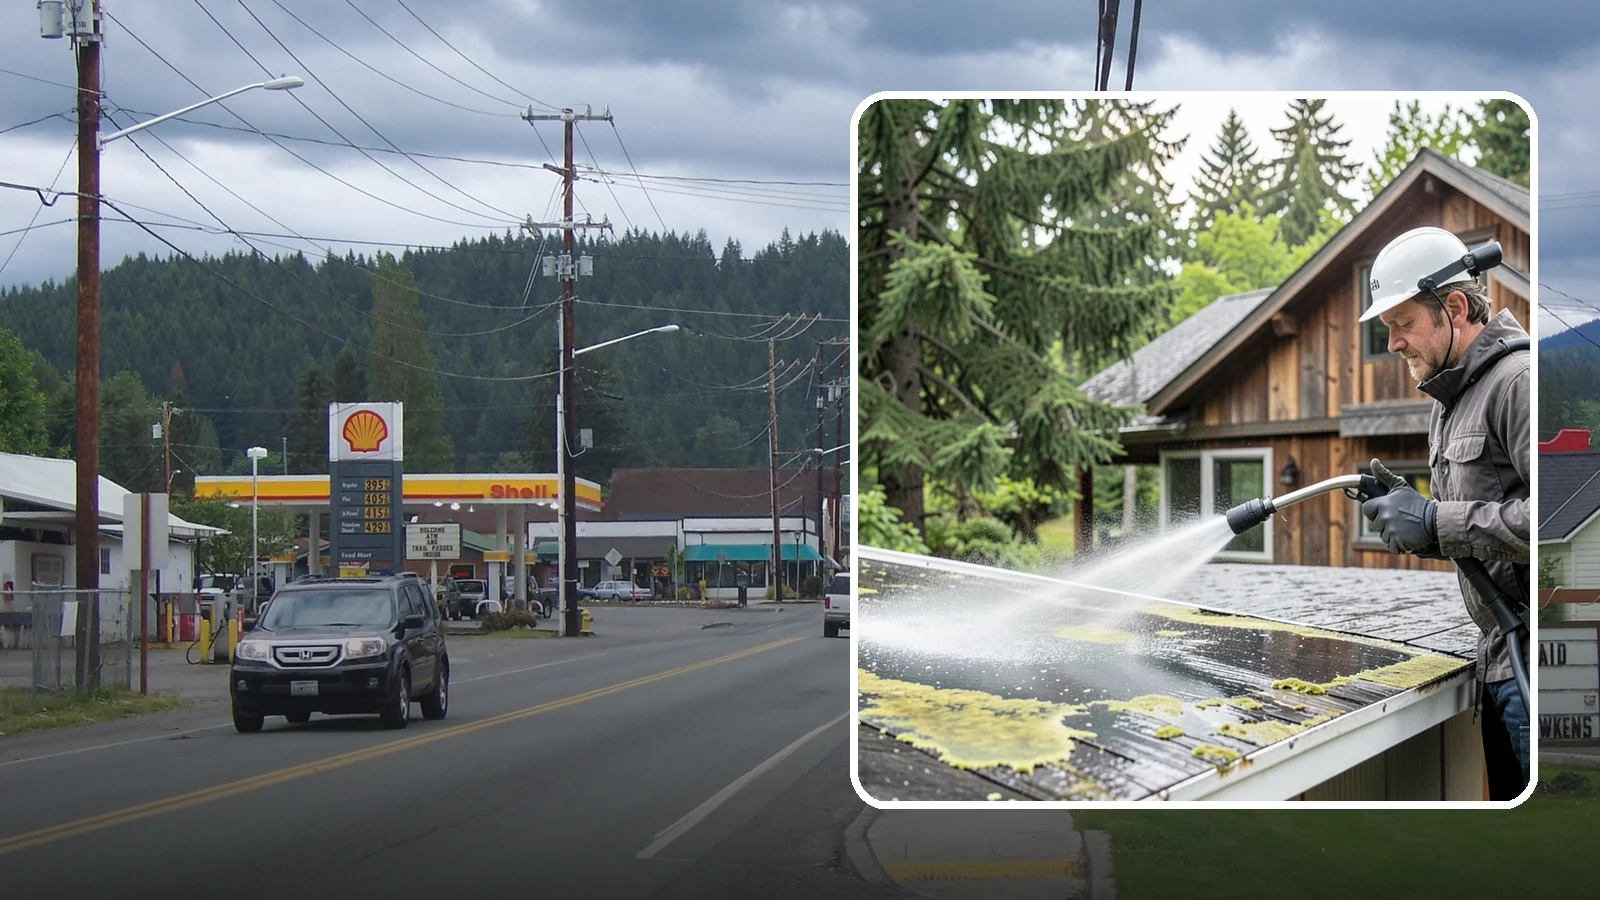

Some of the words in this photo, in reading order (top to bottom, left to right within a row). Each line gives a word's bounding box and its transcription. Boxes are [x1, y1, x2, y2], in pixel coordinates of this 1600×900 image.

[366, 480, 383, 490] 395
[490, 484, 547, 499] Shell
[366, 494, 383, 504] 405
[366, 508, 383, 517] 415
[366, 523, 383, 532] 429
